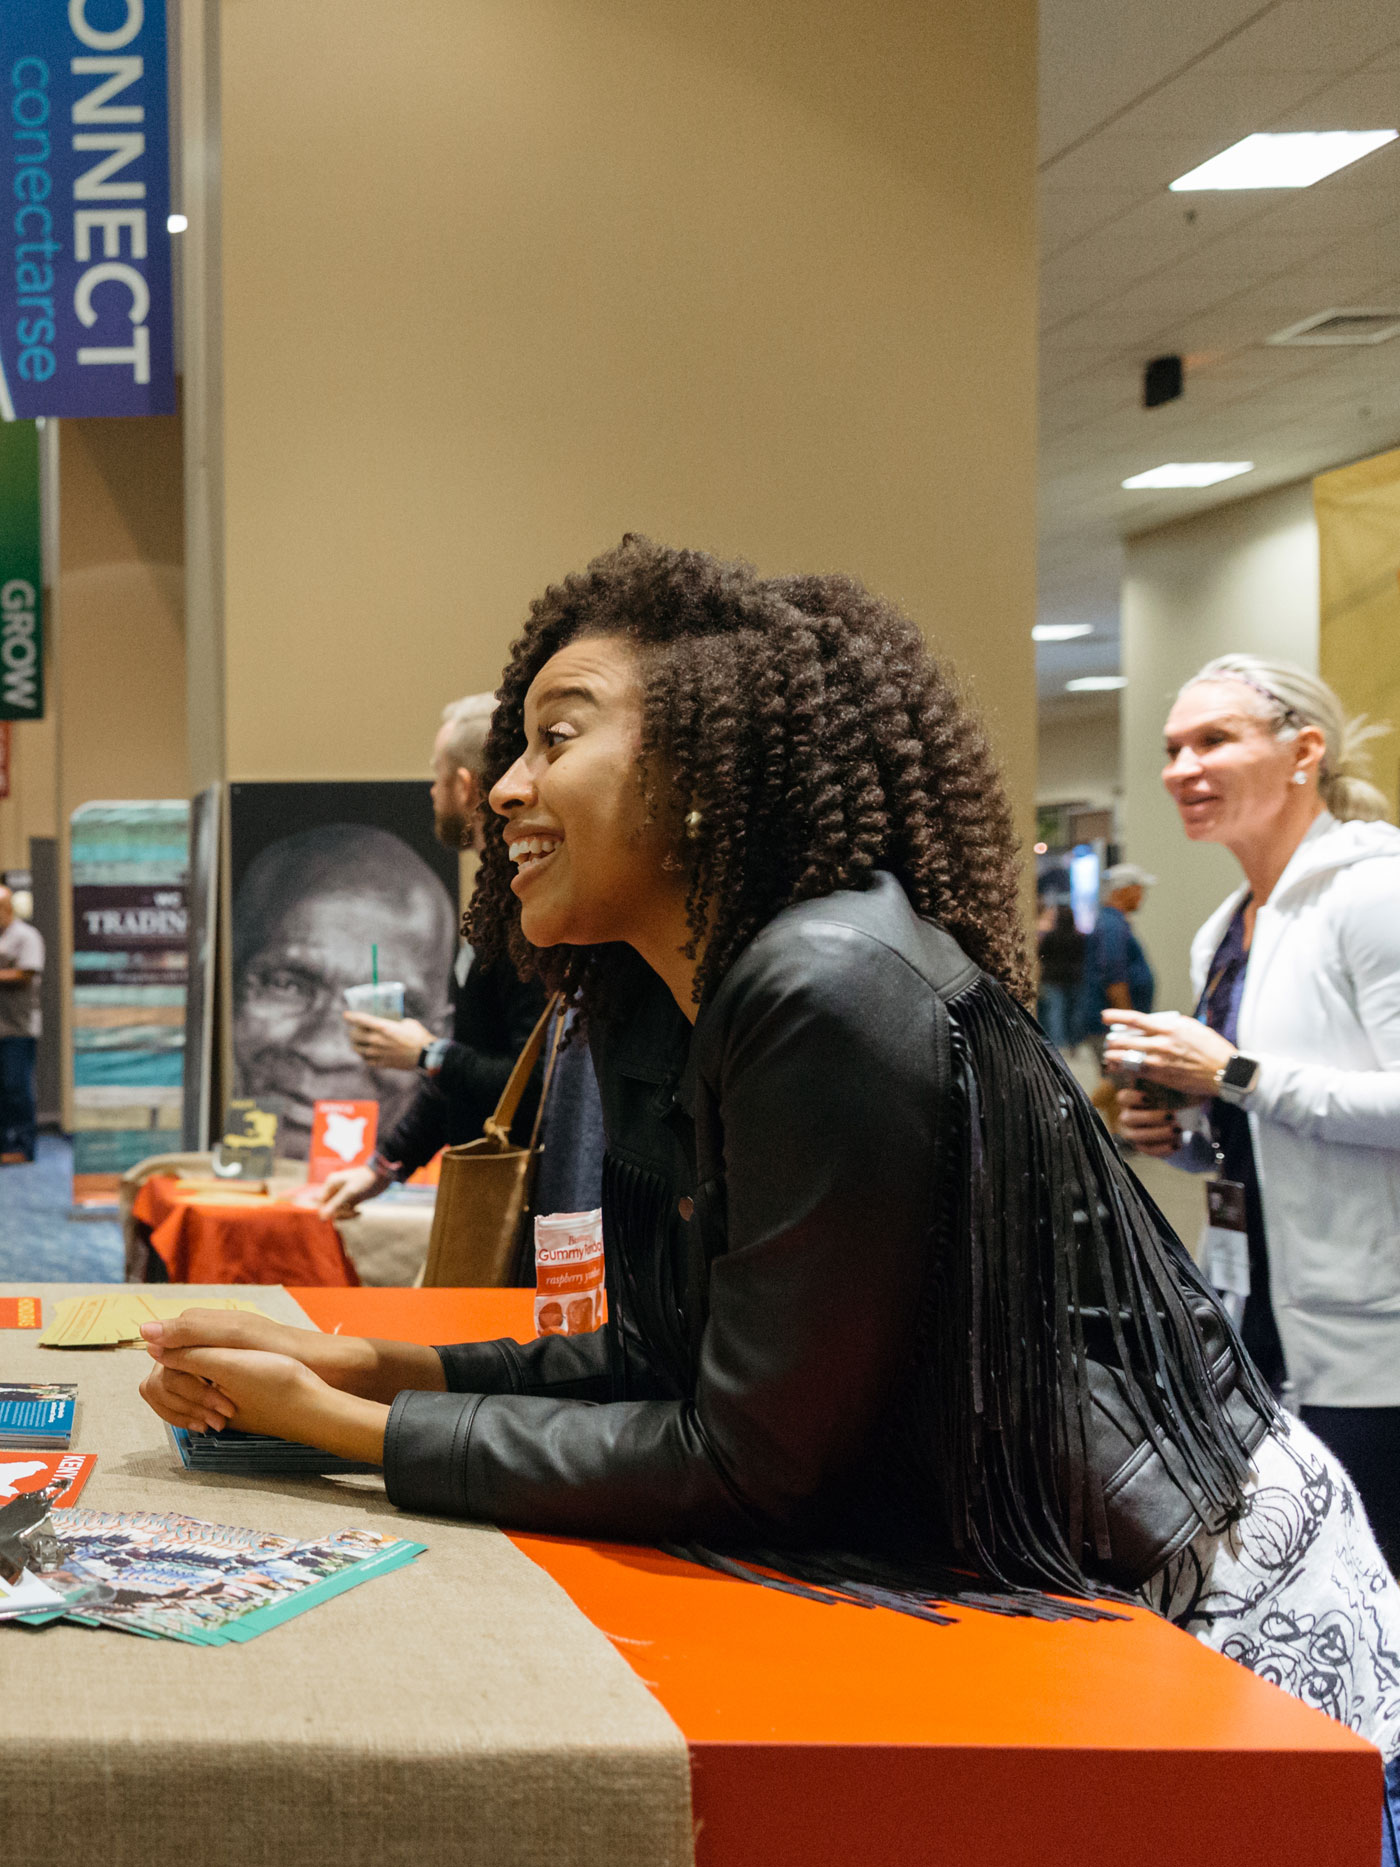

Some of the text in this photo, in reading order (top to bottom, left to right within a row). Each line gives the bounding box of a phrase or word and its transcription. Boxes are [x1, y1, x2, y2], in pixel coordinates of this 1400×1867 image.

[11, 56, 61, 382] conectarse
[68, 0, 150, 384] ONNECT
[1, 578, 37, 709] GROW
[538, 1248, 583, 1261] Gummy
[545, 1272, 583, 1287] raspberry
